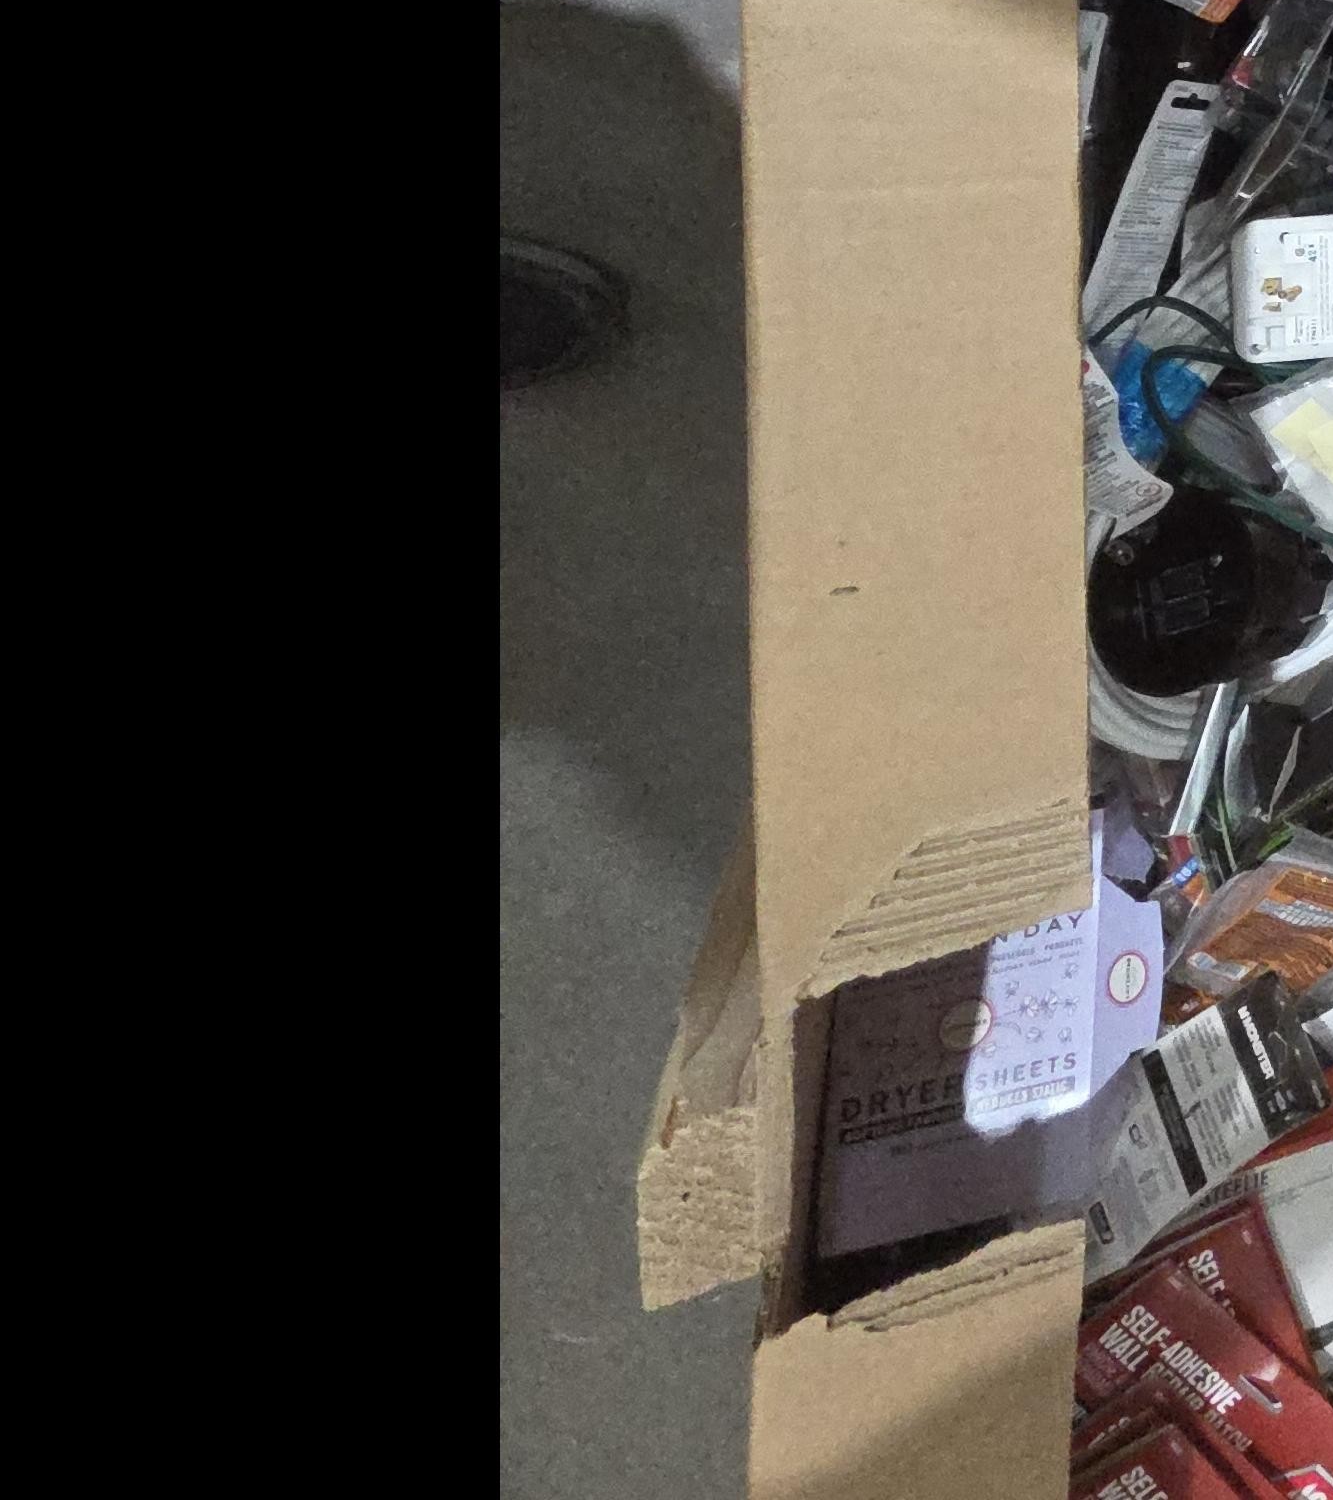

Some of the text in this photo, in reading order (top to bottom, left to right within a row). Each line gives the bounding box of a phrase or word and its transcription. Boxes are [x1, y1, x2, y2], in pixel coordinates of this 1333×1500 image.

[1022, 912, 1086, 938] DAY
[1241, 1016, 1275, 1080] MONSTER
[842, 1076, 965, 1119] DRYER
[973, 1051, 1077, 1091] SHEETS
[1097, 1321, 1149, 1374] WALL
[1118, 1301, 1243, 1418] SELF-ADHESIVE
